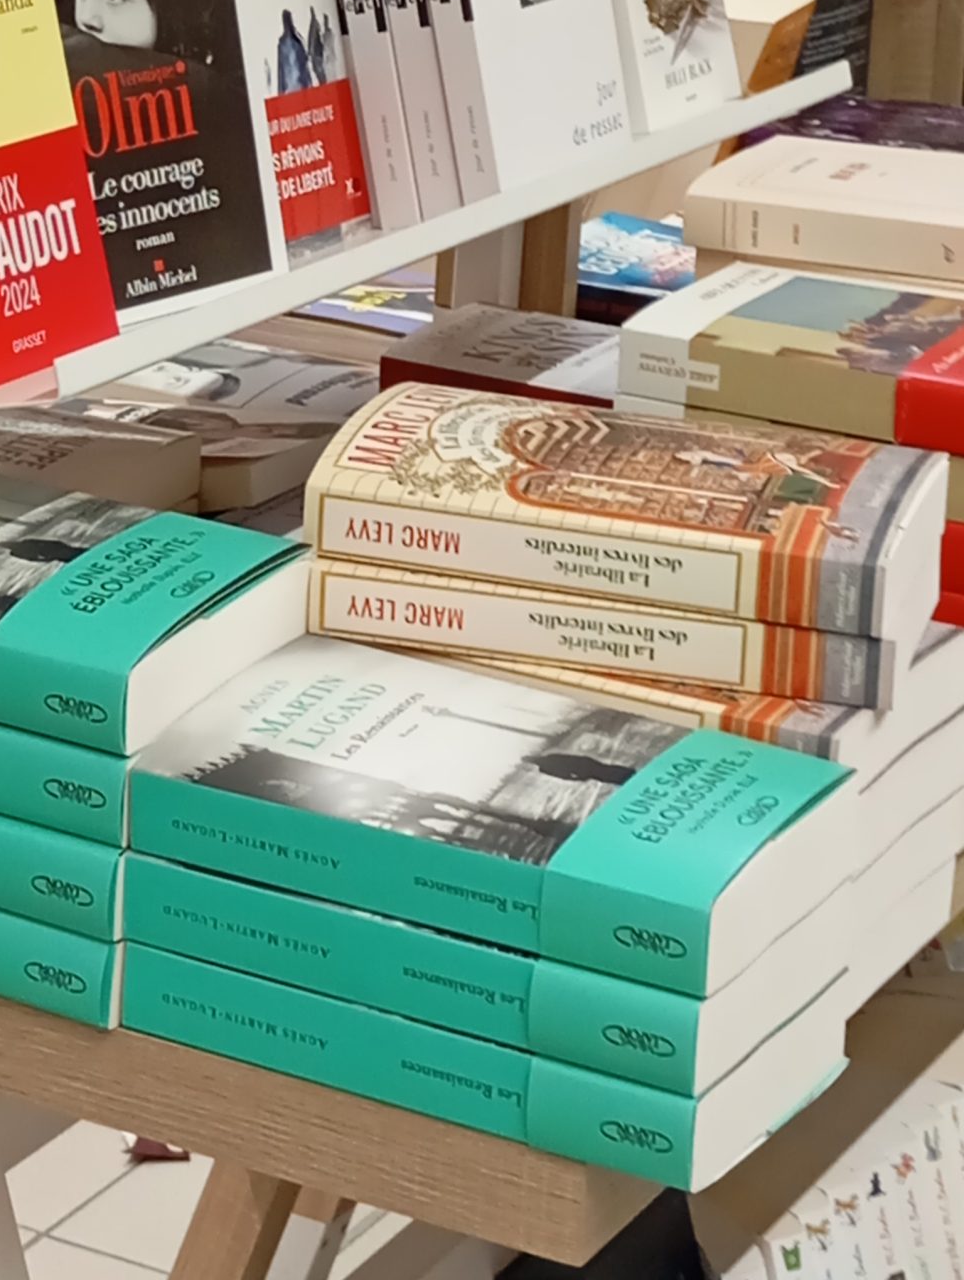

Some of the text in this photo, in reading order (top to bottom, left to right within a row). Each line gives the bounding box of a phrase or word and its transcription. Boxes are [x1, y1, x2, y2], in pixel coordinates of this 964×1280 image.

[74, 60, 199, 158] Olmi
[87, 157, 204, 202] Le courage
[281, 160, 336, 200] DE LIBERTÉ
[96, 185, 221, 236] es innocents
[136, 230, 175, 251] roman
[0, 274, 42, 319] 2024
[125, 265, 198, 299] Albin Michel
[11, 330, 47, 355] GRASSET
[348, 408, 429, 469] MARC
[110, 532, 158, 572] SAGA
[343, 516, 462, 556] MARC LEVY
[523, 537, 684, 575] des livres interdits
[552, 559, 651, 590] La librairie
[345, 594, 465, 632] MARC LEVY
[526, 610, 688, 647] des livres interdits
[556, 633, 656, 663] La librairie
[249, 674, 348, 744] MARTIN
[286, 680, 388, 755] LUGAND
[337, 738, 370, 764] Les
[623, 786, 669, 815] UNE
[654, 756, 709, 788] SAGA
[413, 874, 509, 914] Renaissances
[402, 965, 499, 1007] Renaissances
[400, 1058, 496, 1102] Renaissances
